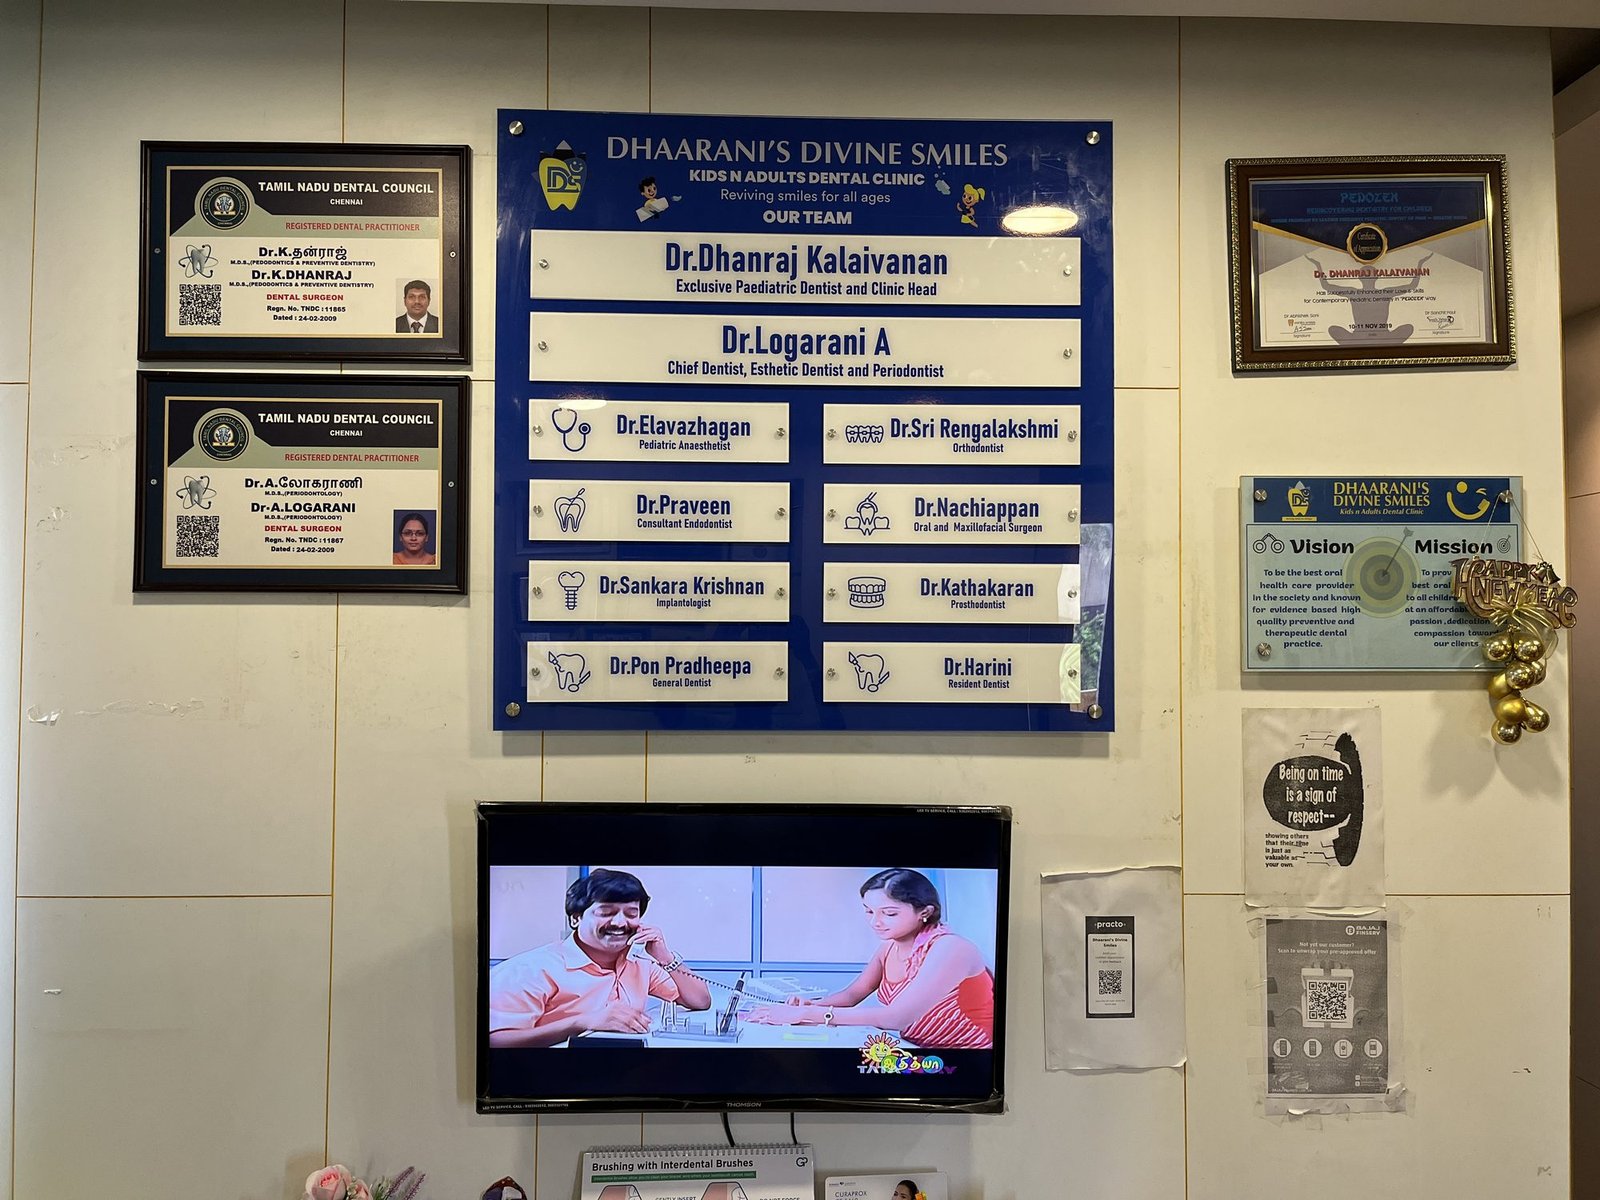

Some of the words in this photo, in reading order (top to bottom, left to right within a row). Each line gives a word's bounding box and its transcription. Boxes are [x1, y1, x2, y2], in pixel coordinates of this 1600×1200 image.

[607, 136, 791, 163] DHAARANI'S
[802, 141, 902, 165] DIVINE
[912, 143, 1008, 167] SMILES
[689, 169, 727, 182] KIDS
[730, 170, 741, 183] N
[745, 171, 805, 184] ADULTS
[809, 172, 869, 184] DENTAL
[872, 173, 925, 186] CLINIC
[258, 182, 294, 192] TAMIL
[298, 182, 329, 192] NADU
[334, 183, 379, 193] DENTAL
[382, 183, 434, 193] COUNCIL
[721, 189, 774, 203] Reviving
[777, 190, 817, 202] smiles
[822, 191, 838, 202] for
[843, 192, 857, 202] all
[862, 194, 890, 206] ages
[763, 210, 799, 223] OUR
[803, 210, 852, 224] TEAM
[286, 222, 331, 230] REGISTERED
[334, 223, 363, 231] DENTAL
[365, 223, 420, 231] PRACTITIONER
[666, 242, 797, 281] Dr.Dhanraj
[807, 245, 948, 275] Kalaivanan
[252, 270, 351, 280] Dr.K.DHANRAJ
[1330, 269, 1370, 278] DHANRAJ
[1372, 268, 1429, 277] KALAIVANAN
[676, 279, 732, 294] Exclusive
[736, 280, 796, 295] Paediatric
[800, 282, 842, 295] Dentist
[846, 282, 867, 295] and
[872, 282, 904, 296] Clinic
[908, 282, 937, 296] Head
[723, 325, 866, 362] Dr.Logarani
[874, 328, 891, 356] A
[668, 360, 698, 375] Chief
[702, 361, 747, 377] Dentist,
[751, 362, 798, 376] Esthetic
[802, 363, 844, 377] Dentist
[848, 363, 869, 377] and
[873, 364, 944, 377] Periodontist
[258, 413, 294, 423] TAMIL
[298, 414, 329, 423] NADU
[334, 414, 379, 424] DENTAL
[382, 414, 433, 424] COUNCIL
[617, 414, 750, 441] Dr.Elavazhagan
[891, 418, 934, 438] Dr.Sri
[941, 418, 1058, 443] Rengalakshmi
[639, 440, 676, 450] Pediatric
[679, 440, 730, 451] Anaesthetist
[953, 443, 1004, 453] Orthodontist
[285, 453, 331, 461] REGISTERED
[364, 454, 419, 462] PRACTITIONER
[1334, 482, 1429, 495] DHAARANI'S
[637, 495, 731, 515] Dr.Praveen
[1333, 496, 1380, 506] DIVINE
[1385, 496, 1430, 507] SMILES
[914, 498, 1039, 522] Dr.Nachiappan
[637, 518, 682, 528] Consultant
[685, 518, 732, 529] Endodontist
[914, 522, 931, 532] Oral
[934, 522, 948, 532] and
[954, 522, 1006, 532] Maxillofacial
[1009, 523, 1042, 534] Surgeon
[1290, 539, 1354, 554] Vision
[1415, 539, 1493, 554] Mission
[600, 576, 687, 595] Dr.Sankara
[694, 576, 764, 595] Krishnan
[921, 578, 1034, 597] Dr.Kathakaran
[1316, 582, 1354, 590] provider
[656, 598, 711, 609] Implantologist
[1280, 594, 1310, 602] society
[951, 600, 1005, 610] Prosthodontist
[1341, 606, 1361, 614] high
[1257, 618, 1287, 626] quality
[1289, 618, 1336, 626] preventive
[1265, 629, 1317, 638] therapeutic
[1414, 630, 1464, 638] compassion
[1284, 641, 1323, 649] practice.
[610, 656, 659, 675] Dr.Pon
[666, 656, 751, 679] Pradheepa
[944, 658, 1012, 676] Dr.Harini
[653, 678, 682, 687] General
[685, 678, 711, 687] Dentist
[949, 679, 980, 689] Resident
[983, 680, 1009, 689] Dentist
[1279, 763, 1305, 783] Being
[1308, 768, 1319, 781] on
[1322, 766, 1344, 781] time
[1286, 787, 1294, 801] is
[1297, 791, 1302, 801] a
[1305, 787, 1324, 805] sign
[1326, 786, 1337, 801] of
[1097, 921, 1123, 929] practo
[592, 1162, 634, 1172] Brushing
[637, 1161, 657, 1170] with
[661, 1160, 711, 1170] Interdental
[716, 1159, 753, 1168] Brushes
